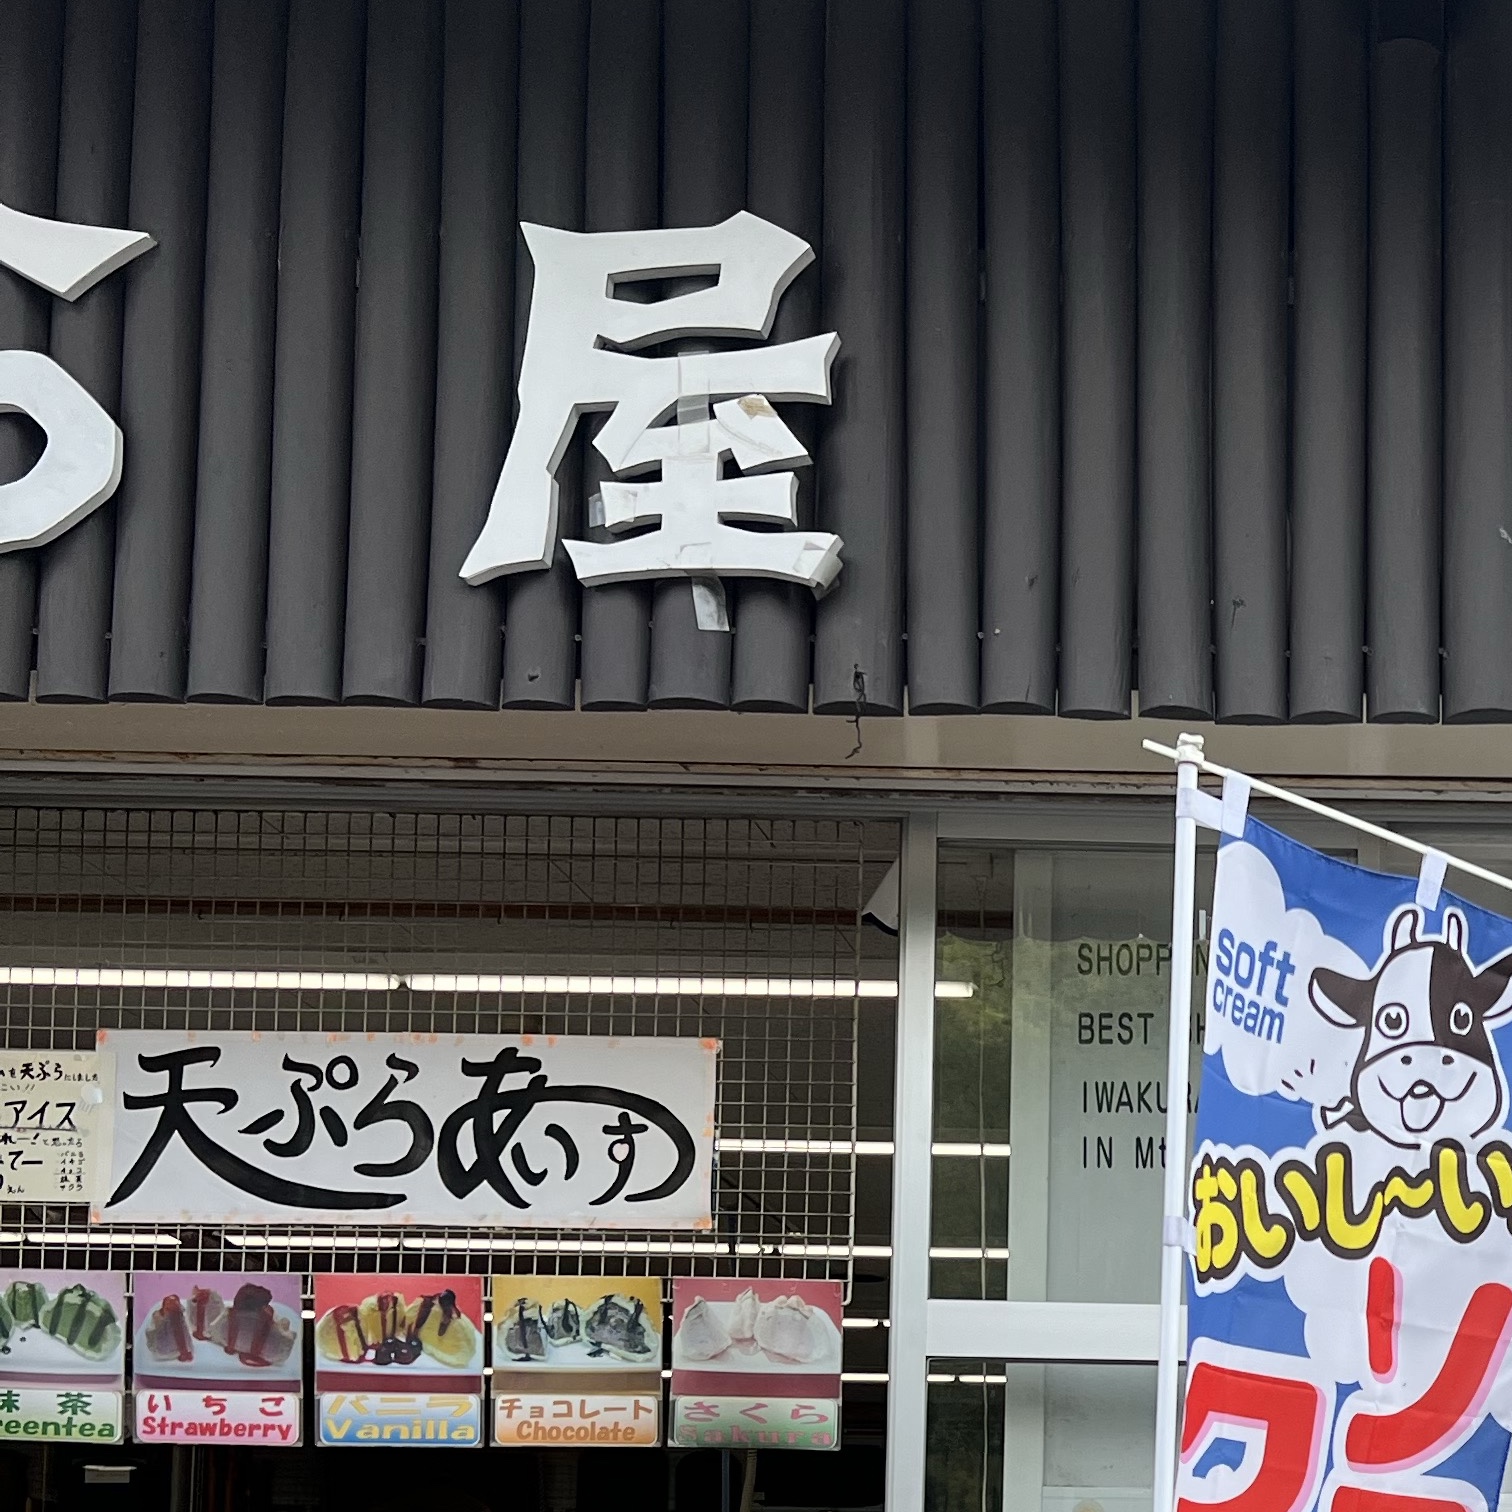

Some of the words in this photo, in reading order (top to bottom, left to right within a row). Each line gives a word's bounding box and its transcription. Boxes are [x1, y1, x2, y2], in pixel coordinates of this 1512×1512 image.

[1215, 928, 1296, 1007] soft
[1212, 978, 1285, 1044] cream
[1078, 1012, 1154, 1045] BEST
[1083, 1136, 1113, 1169] IN
[147, 1394, 285, 1416] いちご
[327, 1395, 472, 1415] バニラ
[499, 1398, 654, 1419] チョコレート
[683, 1401, 830, 1425] さくら
[142, 1416, 292, 1442] Strawberry
[325, 1418, 476, 1441] Vanilla
[516, 1421, 636, 1442] Chocolate
[678, 1424, 833, 1447] Sakura
